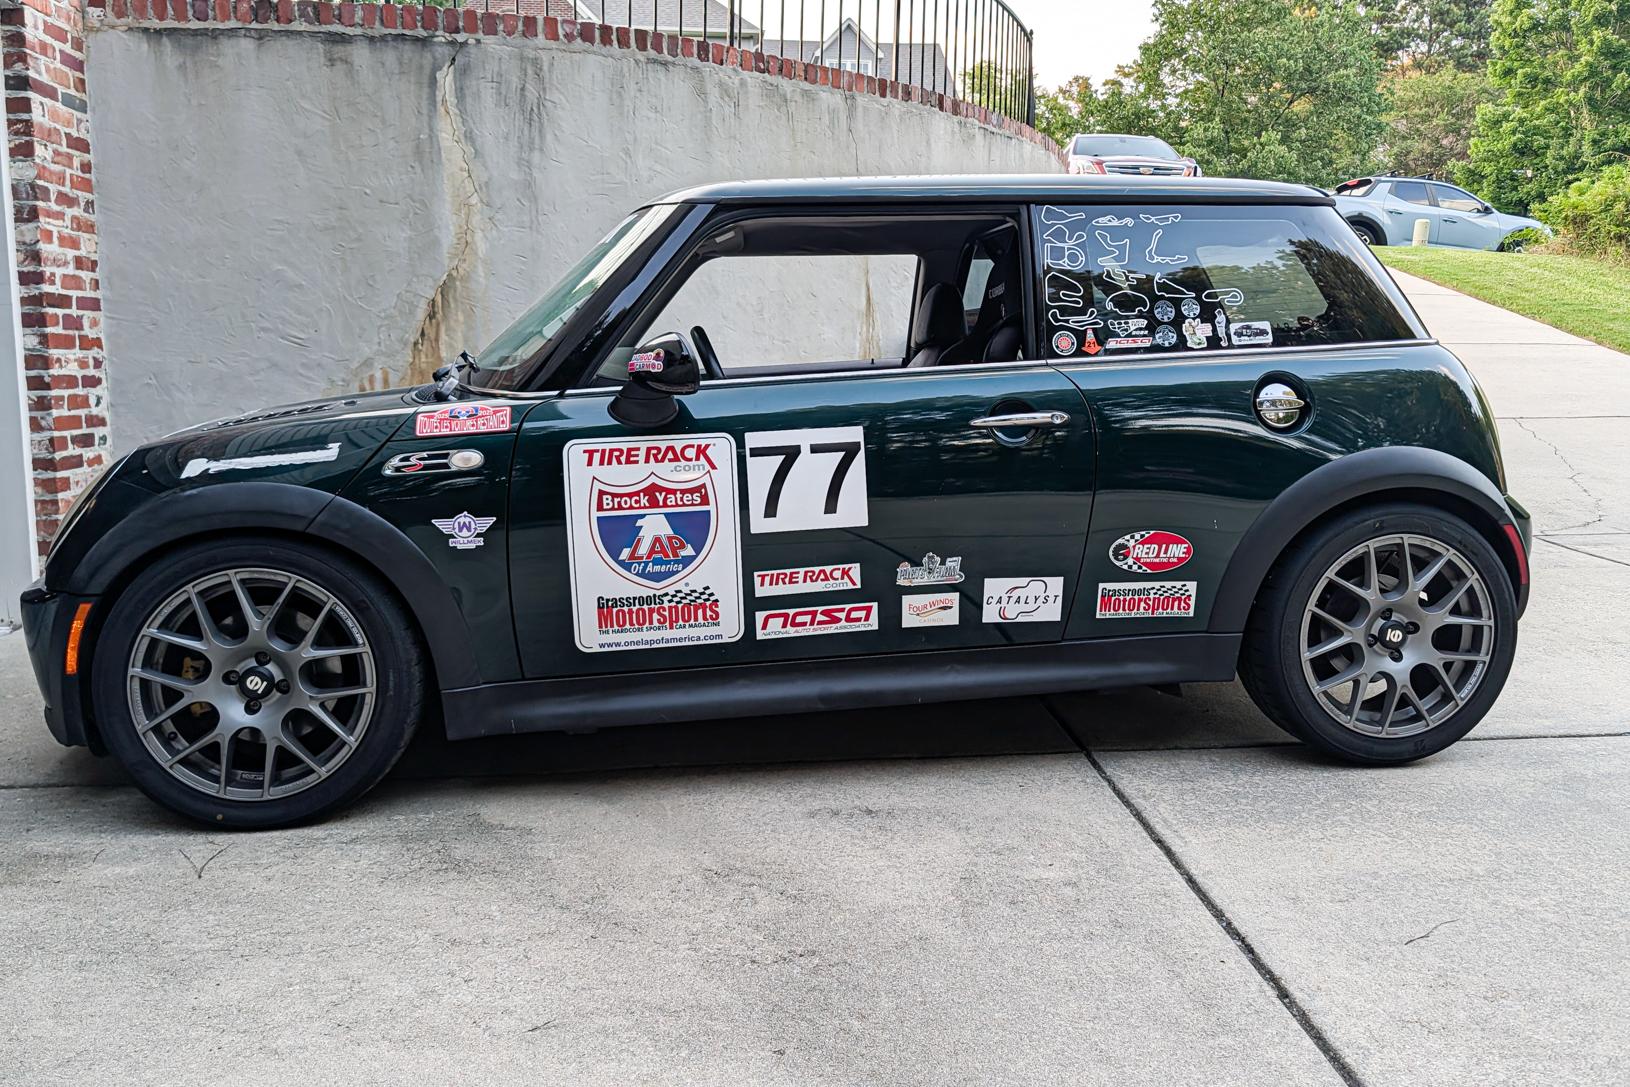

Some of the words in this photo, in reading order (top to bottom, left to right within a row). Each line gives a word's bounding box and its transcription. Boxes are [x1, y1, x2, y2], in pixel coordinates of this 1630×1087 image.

[441, 420, 450, 432] LES
[583, 447, 641, 467] TIRE
[644, 444, 718, 470] RACK
[670, 463, 706, 473] .com
[749, 441, 861, 518] 77
[602, 492, 650, 510] Brock
[626, 534, 688, 562] LAP
[1133, 544, 1158, 558] RED
[631, 563, 644, 574] Of
[646, 562, 682, 574] America
[757, 571, 800, 587] TIRE
[802, 566, 858, 586] RACK
[1101, 587, 1151, 597] Grassroots
[597, 594, 665, 609] Grassroots
[908, 603, 928, 613] FOUR
[928, 598, 954, 609] WINDS
[986, 594, 1060, 606] CATALYST
[1100, 596, 1192, 616] Motorsports
[597, 601, 720, 630] Motorsports
[612, 626, 644, 634] HARDCORE
[646, 624, 668, 632] SPORTS
[674, 622, 687, 630] CAR
[688, 620, 720, 629] MAGAZINE
[598, 633, 723, 649] www.onelapofamerica.com
